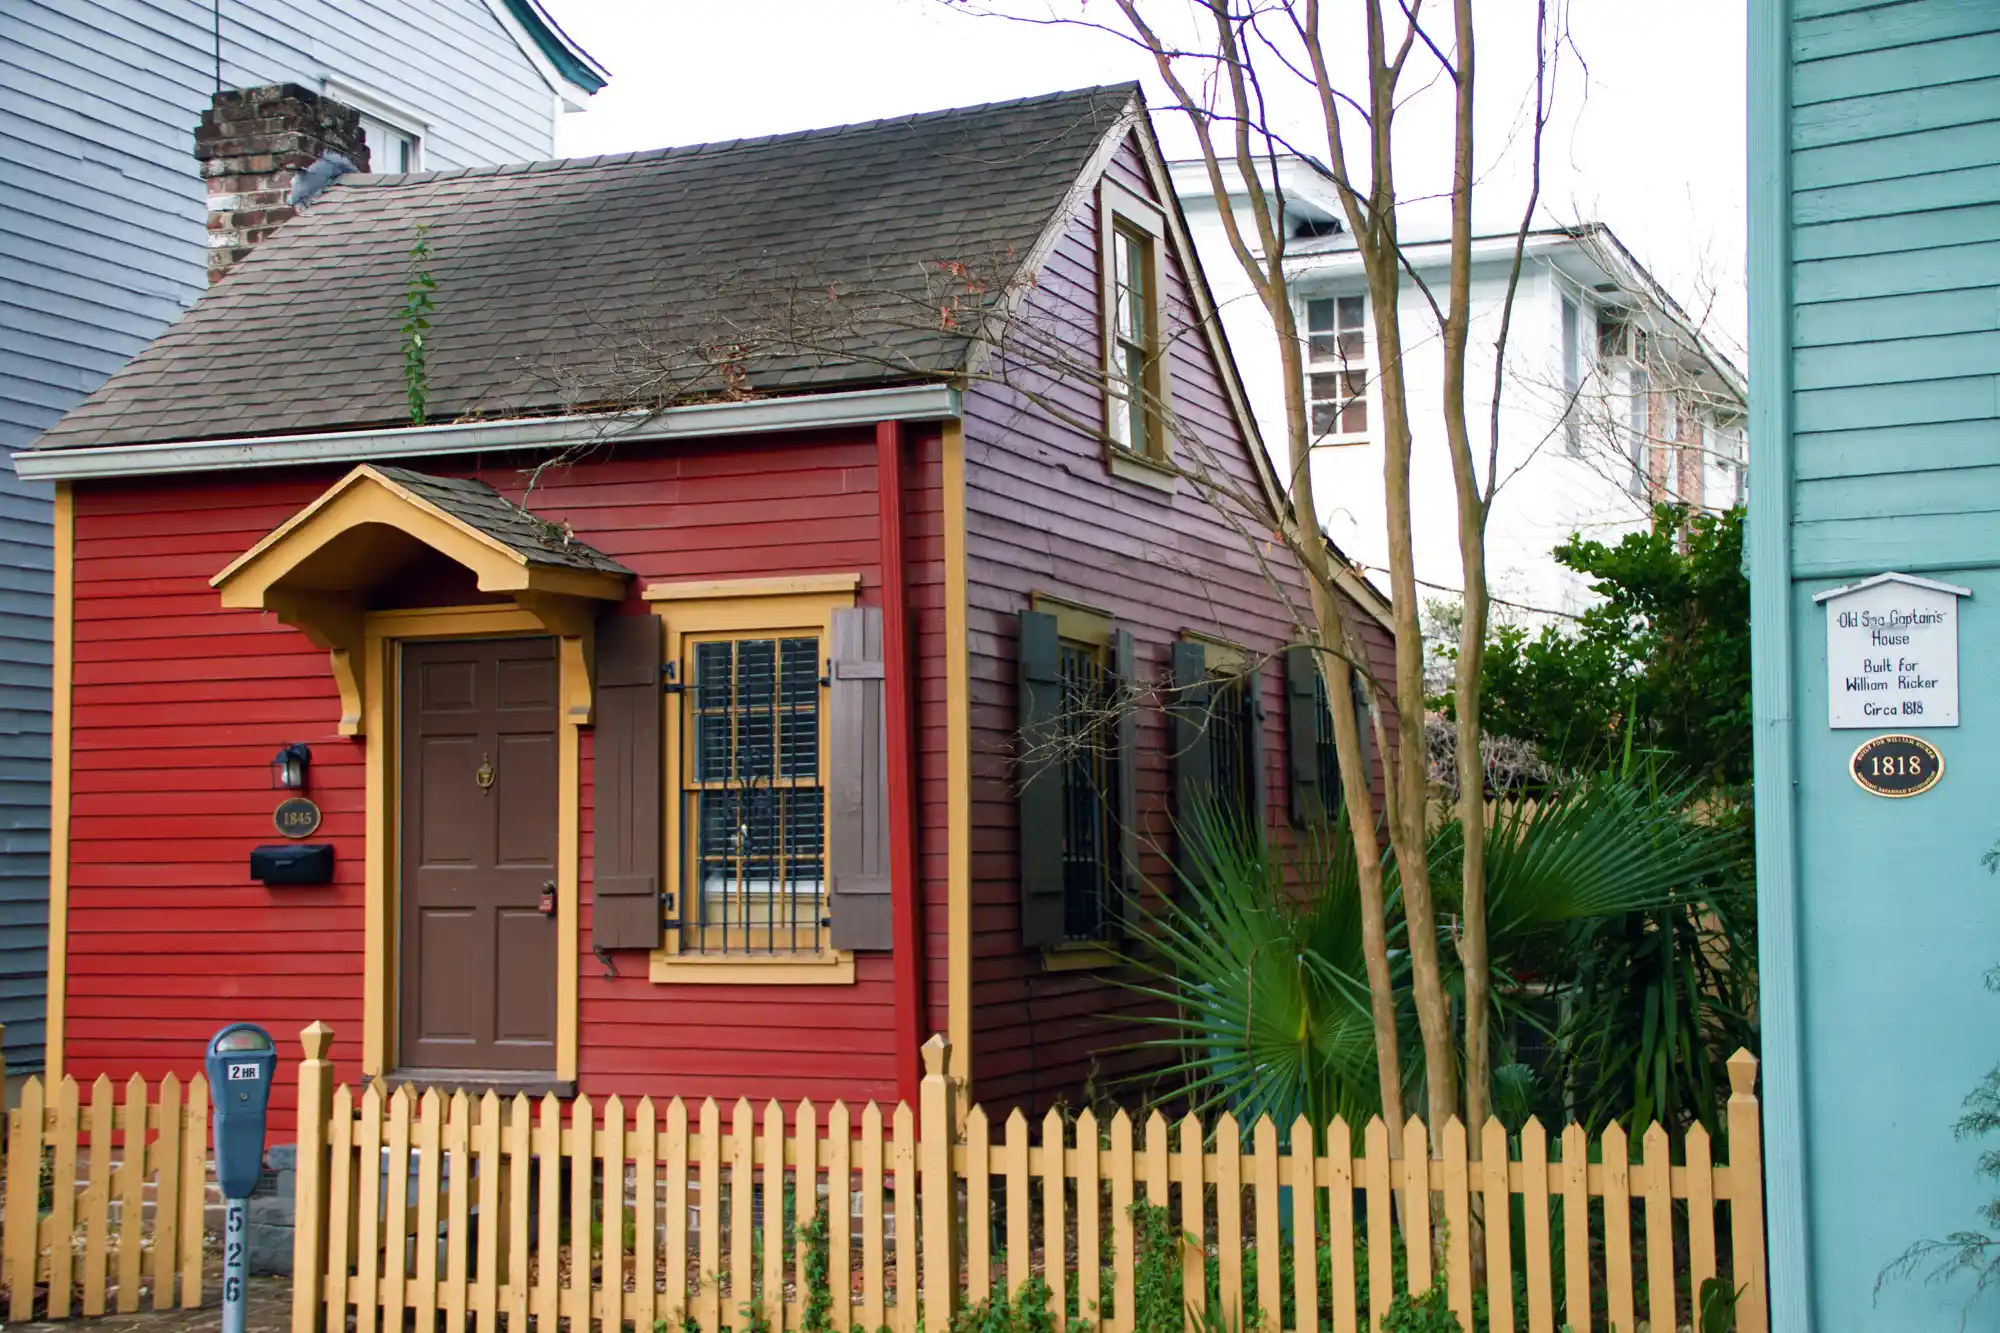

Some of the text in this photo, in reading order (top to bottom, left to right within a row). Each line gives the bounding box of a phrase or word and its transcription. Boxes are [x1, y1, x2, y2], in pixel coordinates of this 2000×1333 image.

[1839, 611, 1858, 628] Old
[1889, 607, 1943, 628] Captain's
[1872, 630, 1910, 647] House
[1863, 657, 1919, 673] Built for
[1845, 674, 1939, 692] William Ricker
[1863, 701, 1924, 716] Circa 1818
[1872, 755, 1921, 776] 1818
[283, 811, 313, 826] 1845
[232, 1066, 256, 1079] 2 HR
